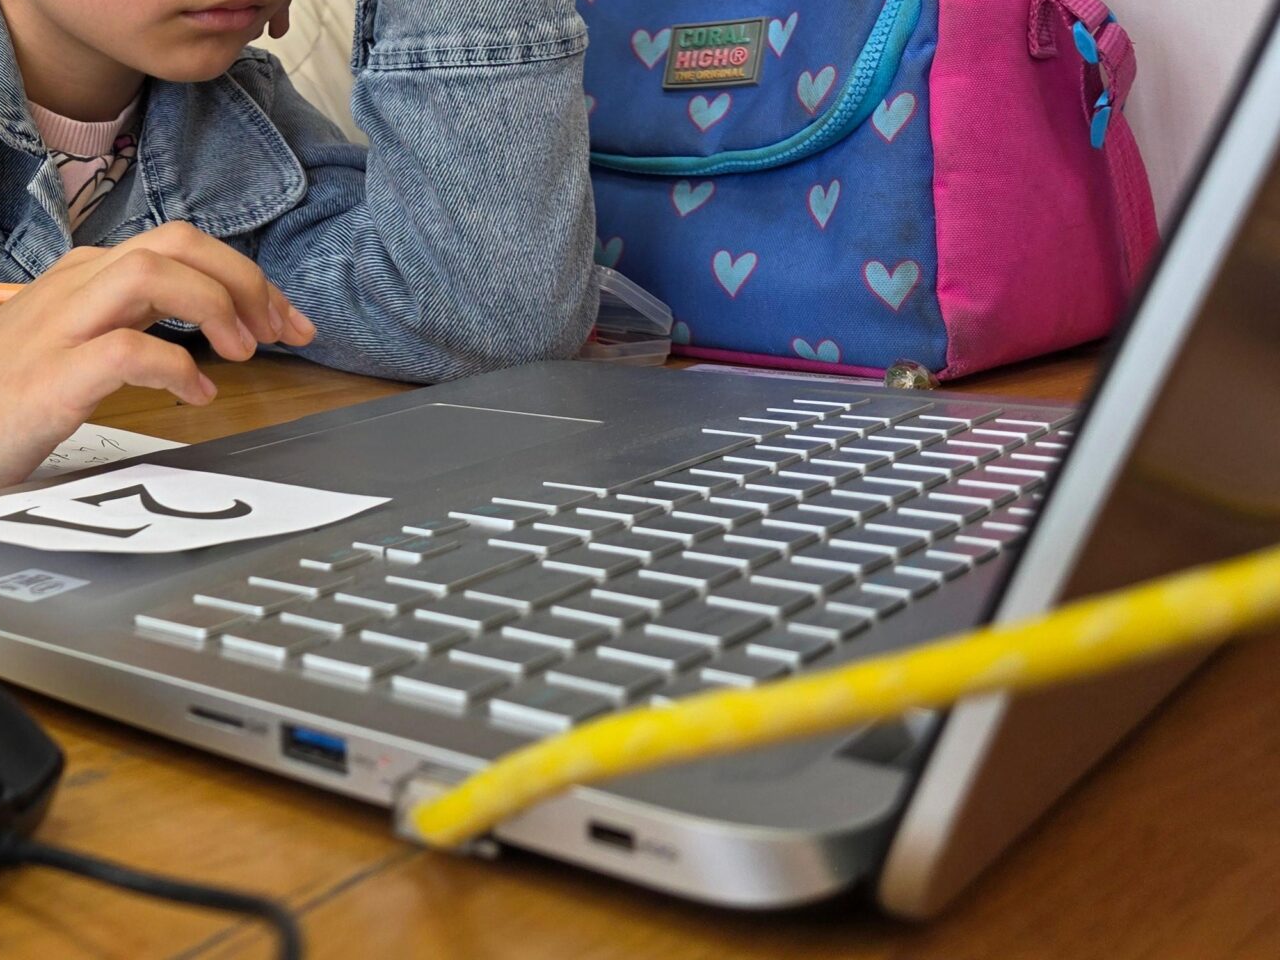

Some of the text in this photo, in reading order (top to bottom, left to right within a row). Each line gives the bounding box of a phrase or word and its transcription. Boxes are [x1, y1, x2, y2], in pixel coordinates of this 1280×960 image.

[680, 25, 750, 46] CORAL
[675, 68, 745, 81] THE ORIGINAL
